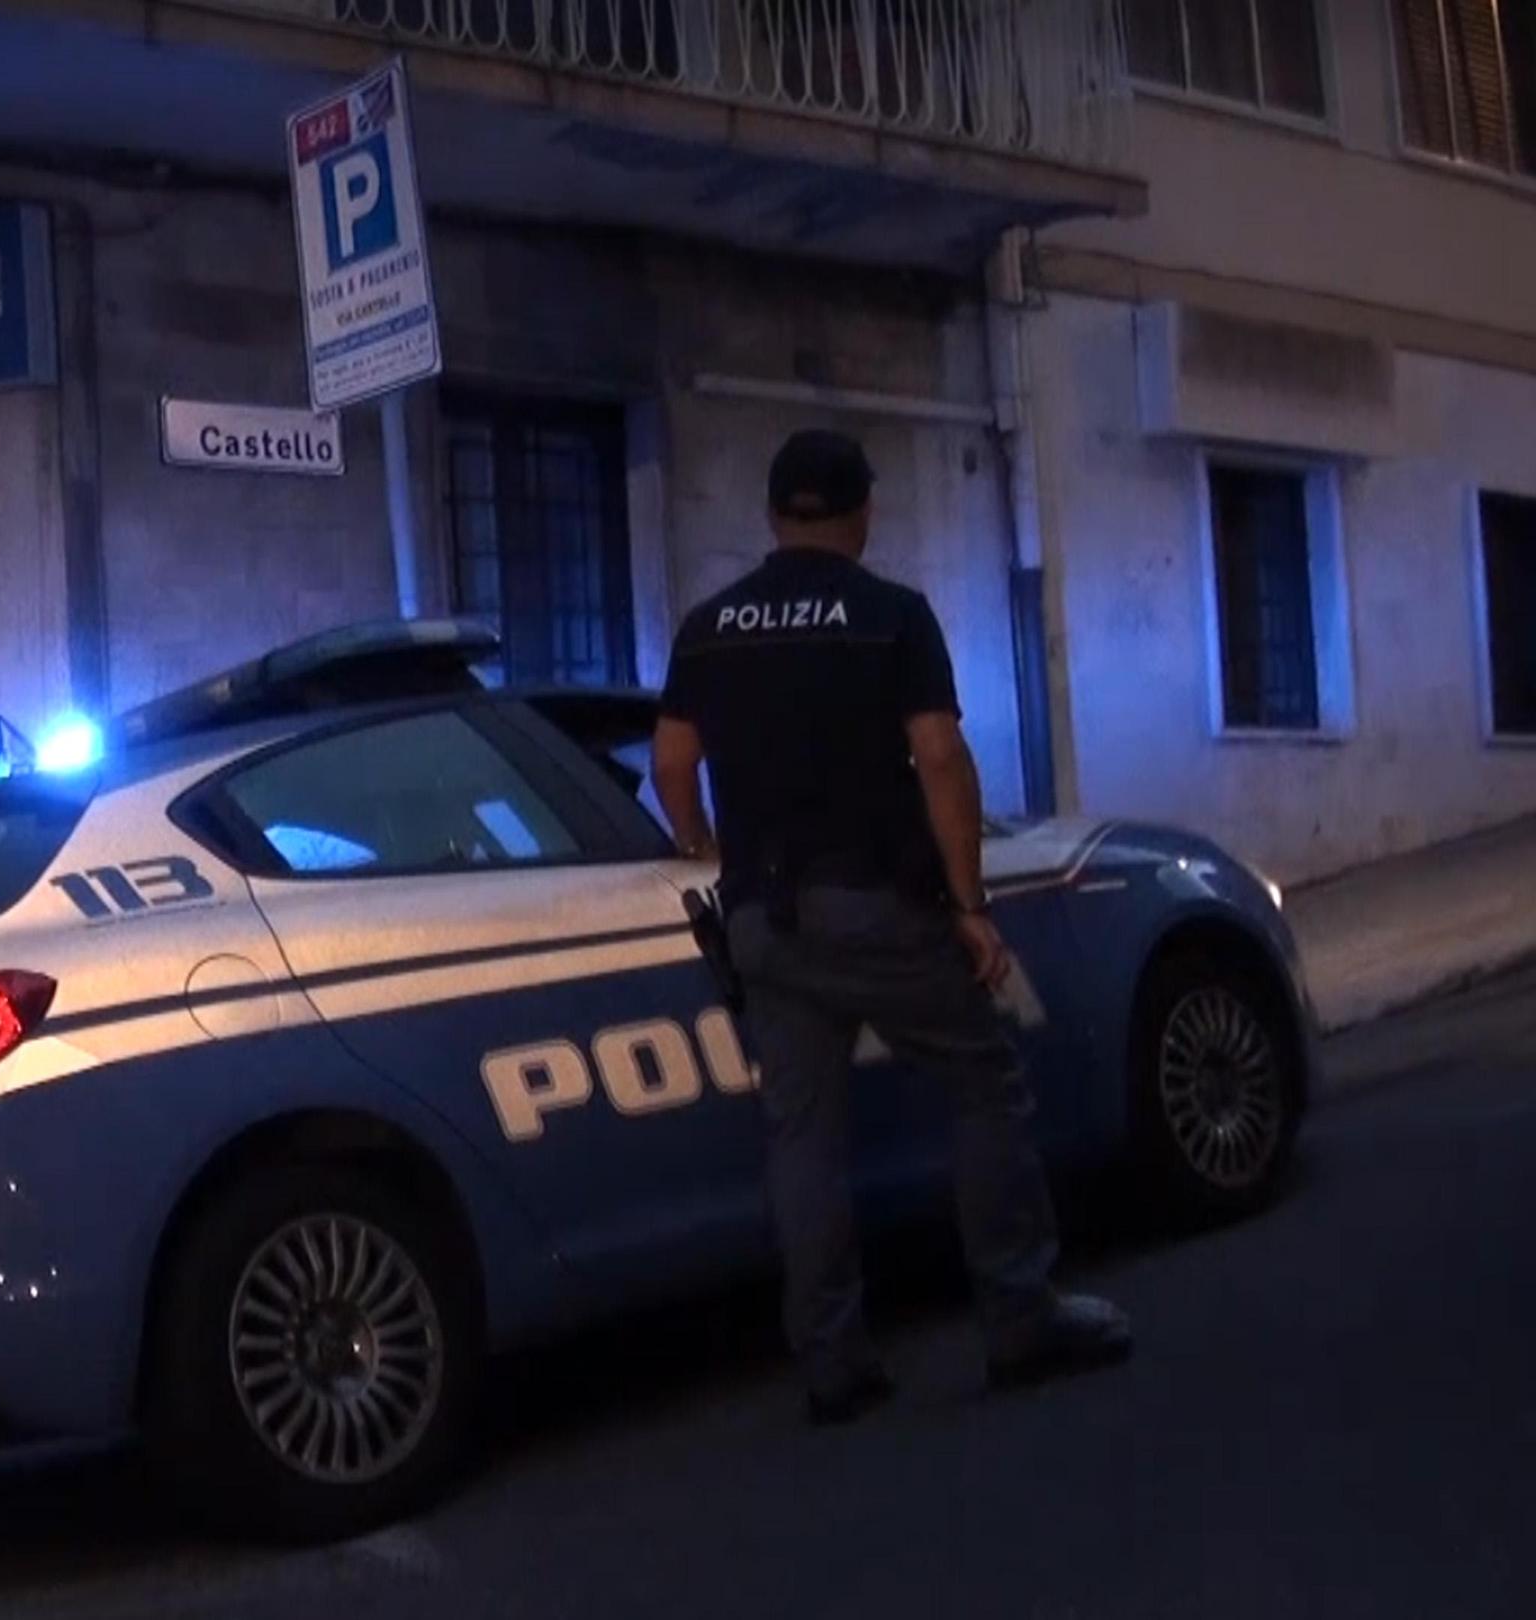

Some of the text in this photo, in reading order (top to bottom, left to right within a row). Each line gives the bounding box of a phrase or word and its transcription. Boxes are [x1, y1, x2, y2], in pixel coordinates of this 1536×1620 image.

[333, 152, 381, 259] P
[200, 425, 333, 462] Castello
[716, 599, 848, 633] POLIZIA
[48, 855, 214, 920] 113
